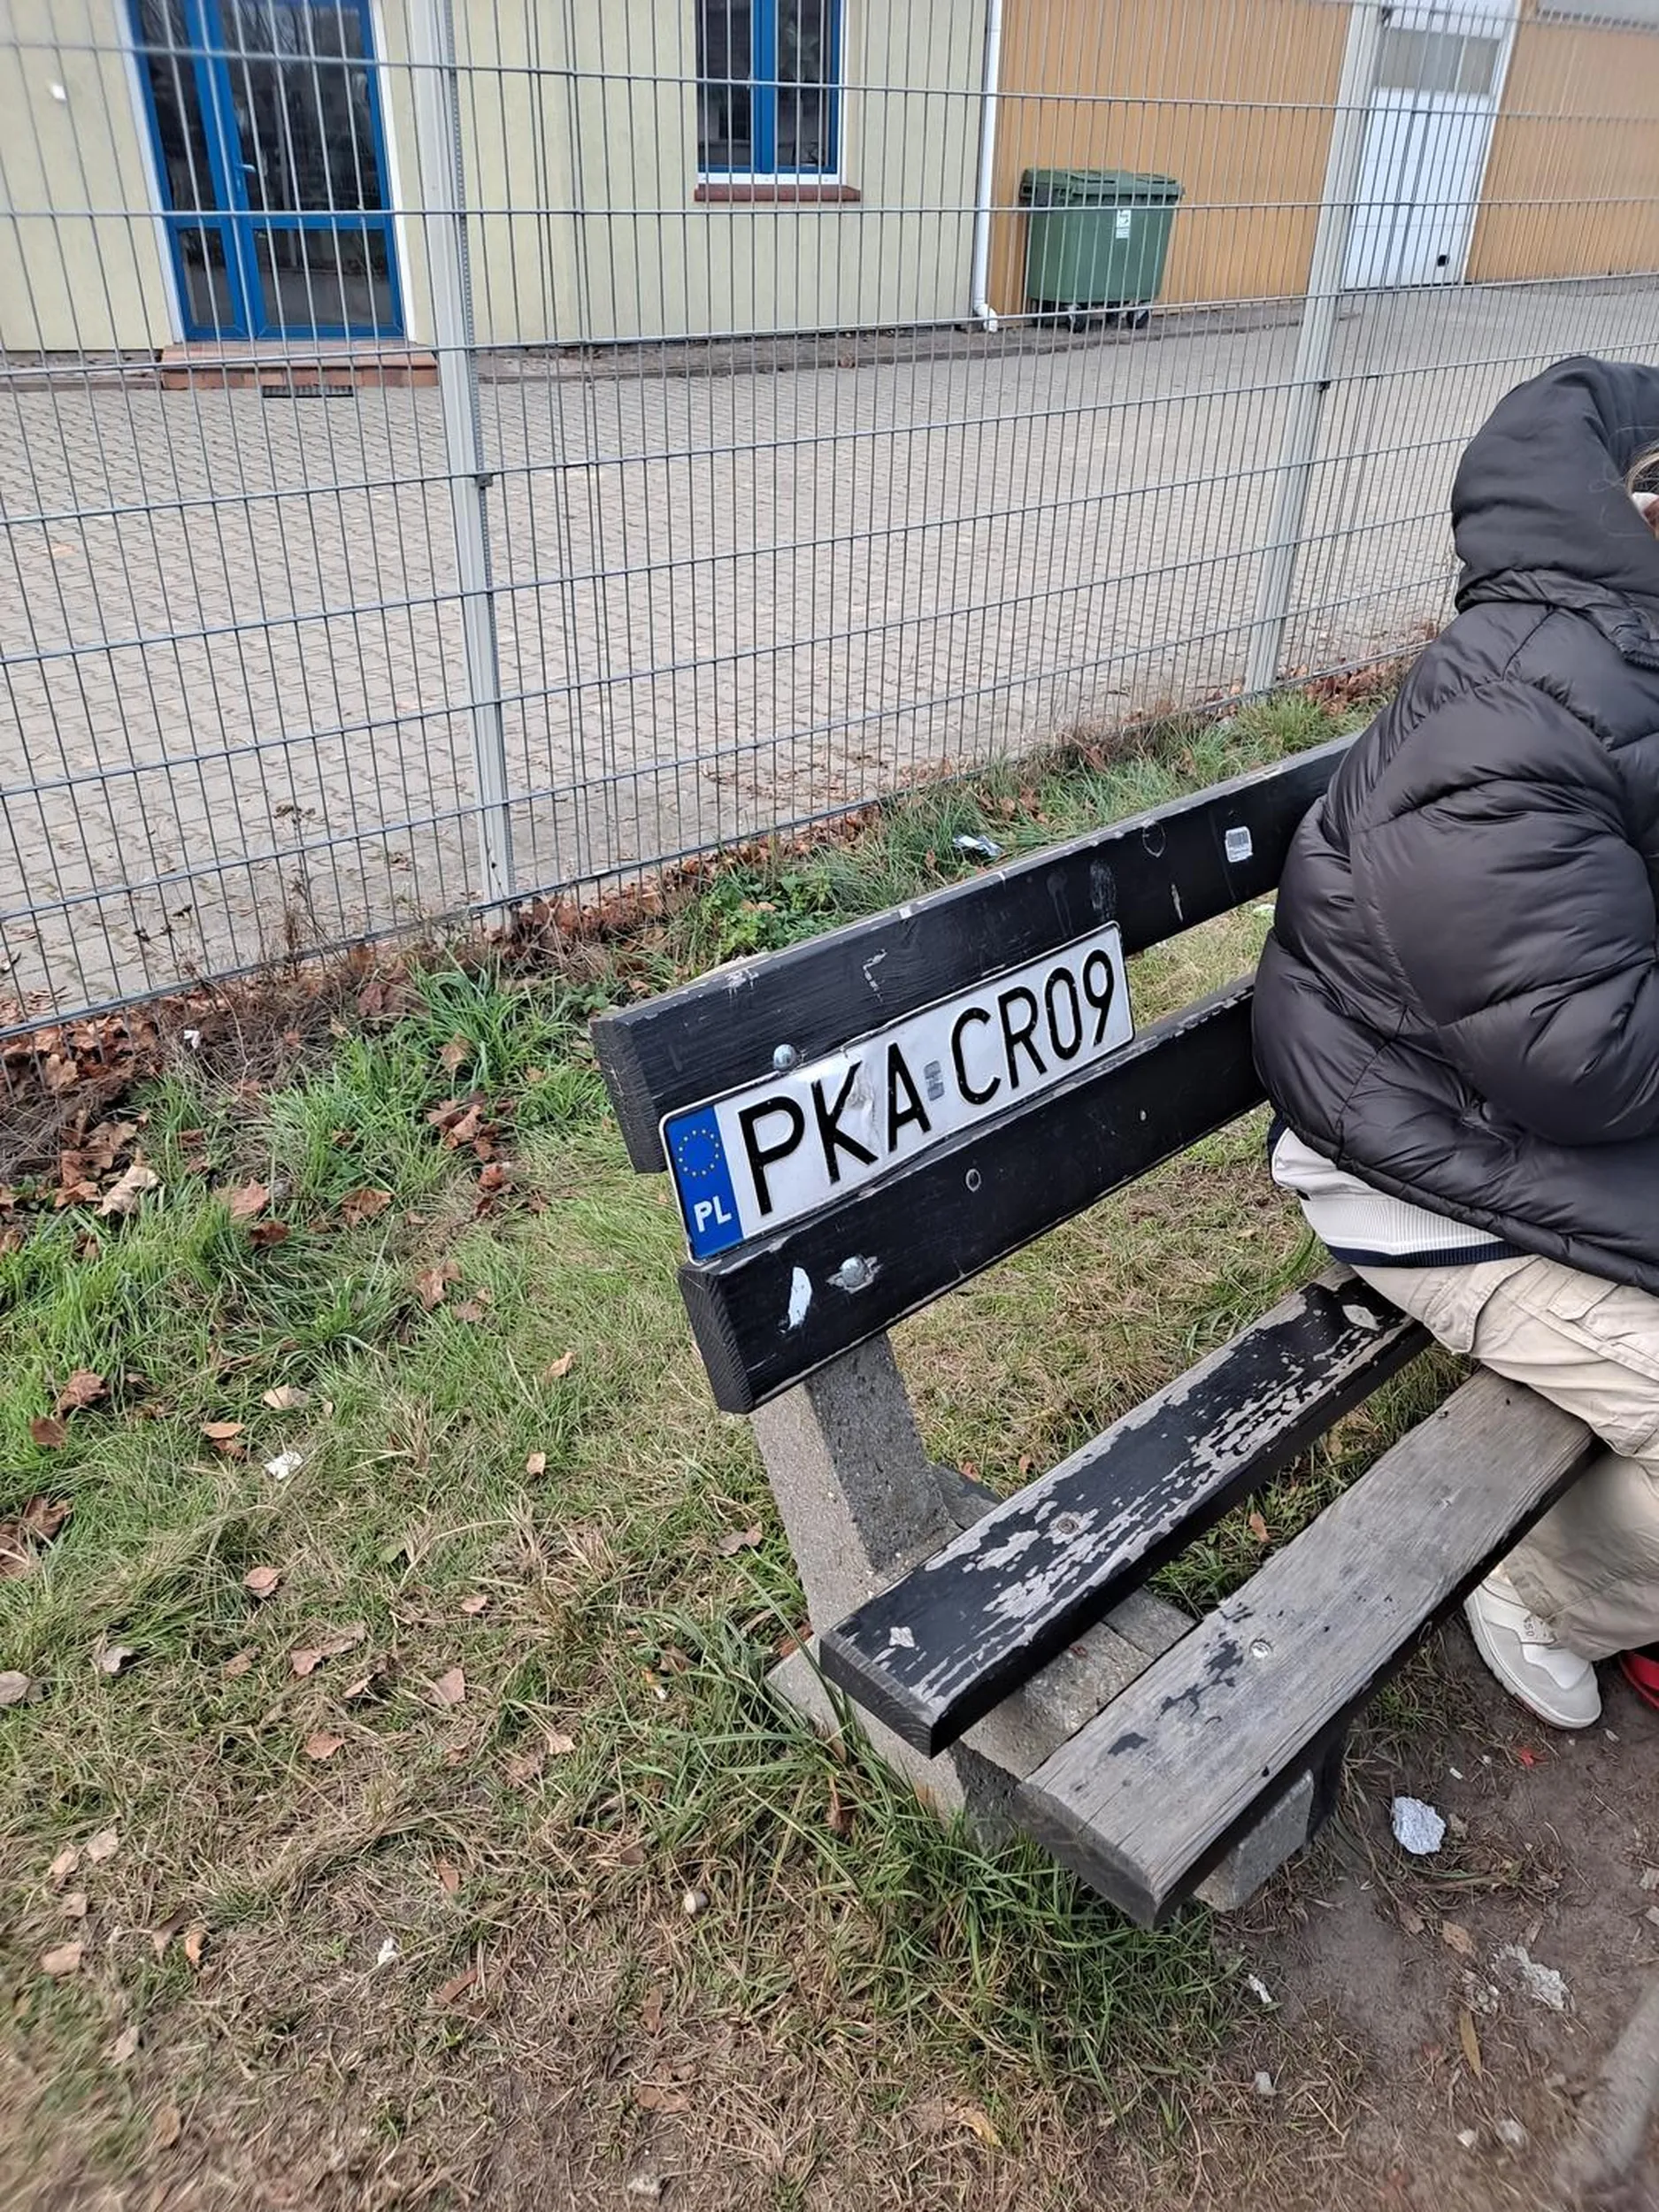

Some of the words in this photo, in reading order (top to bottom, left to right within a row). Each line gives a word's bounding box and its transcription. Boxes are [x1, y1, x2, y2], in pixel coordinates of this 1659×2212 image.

[738, 1041, 932, 1216] PKA
[950, 949, 1116, 1105] CR09
[694, 1198, 733, 1233] PL
